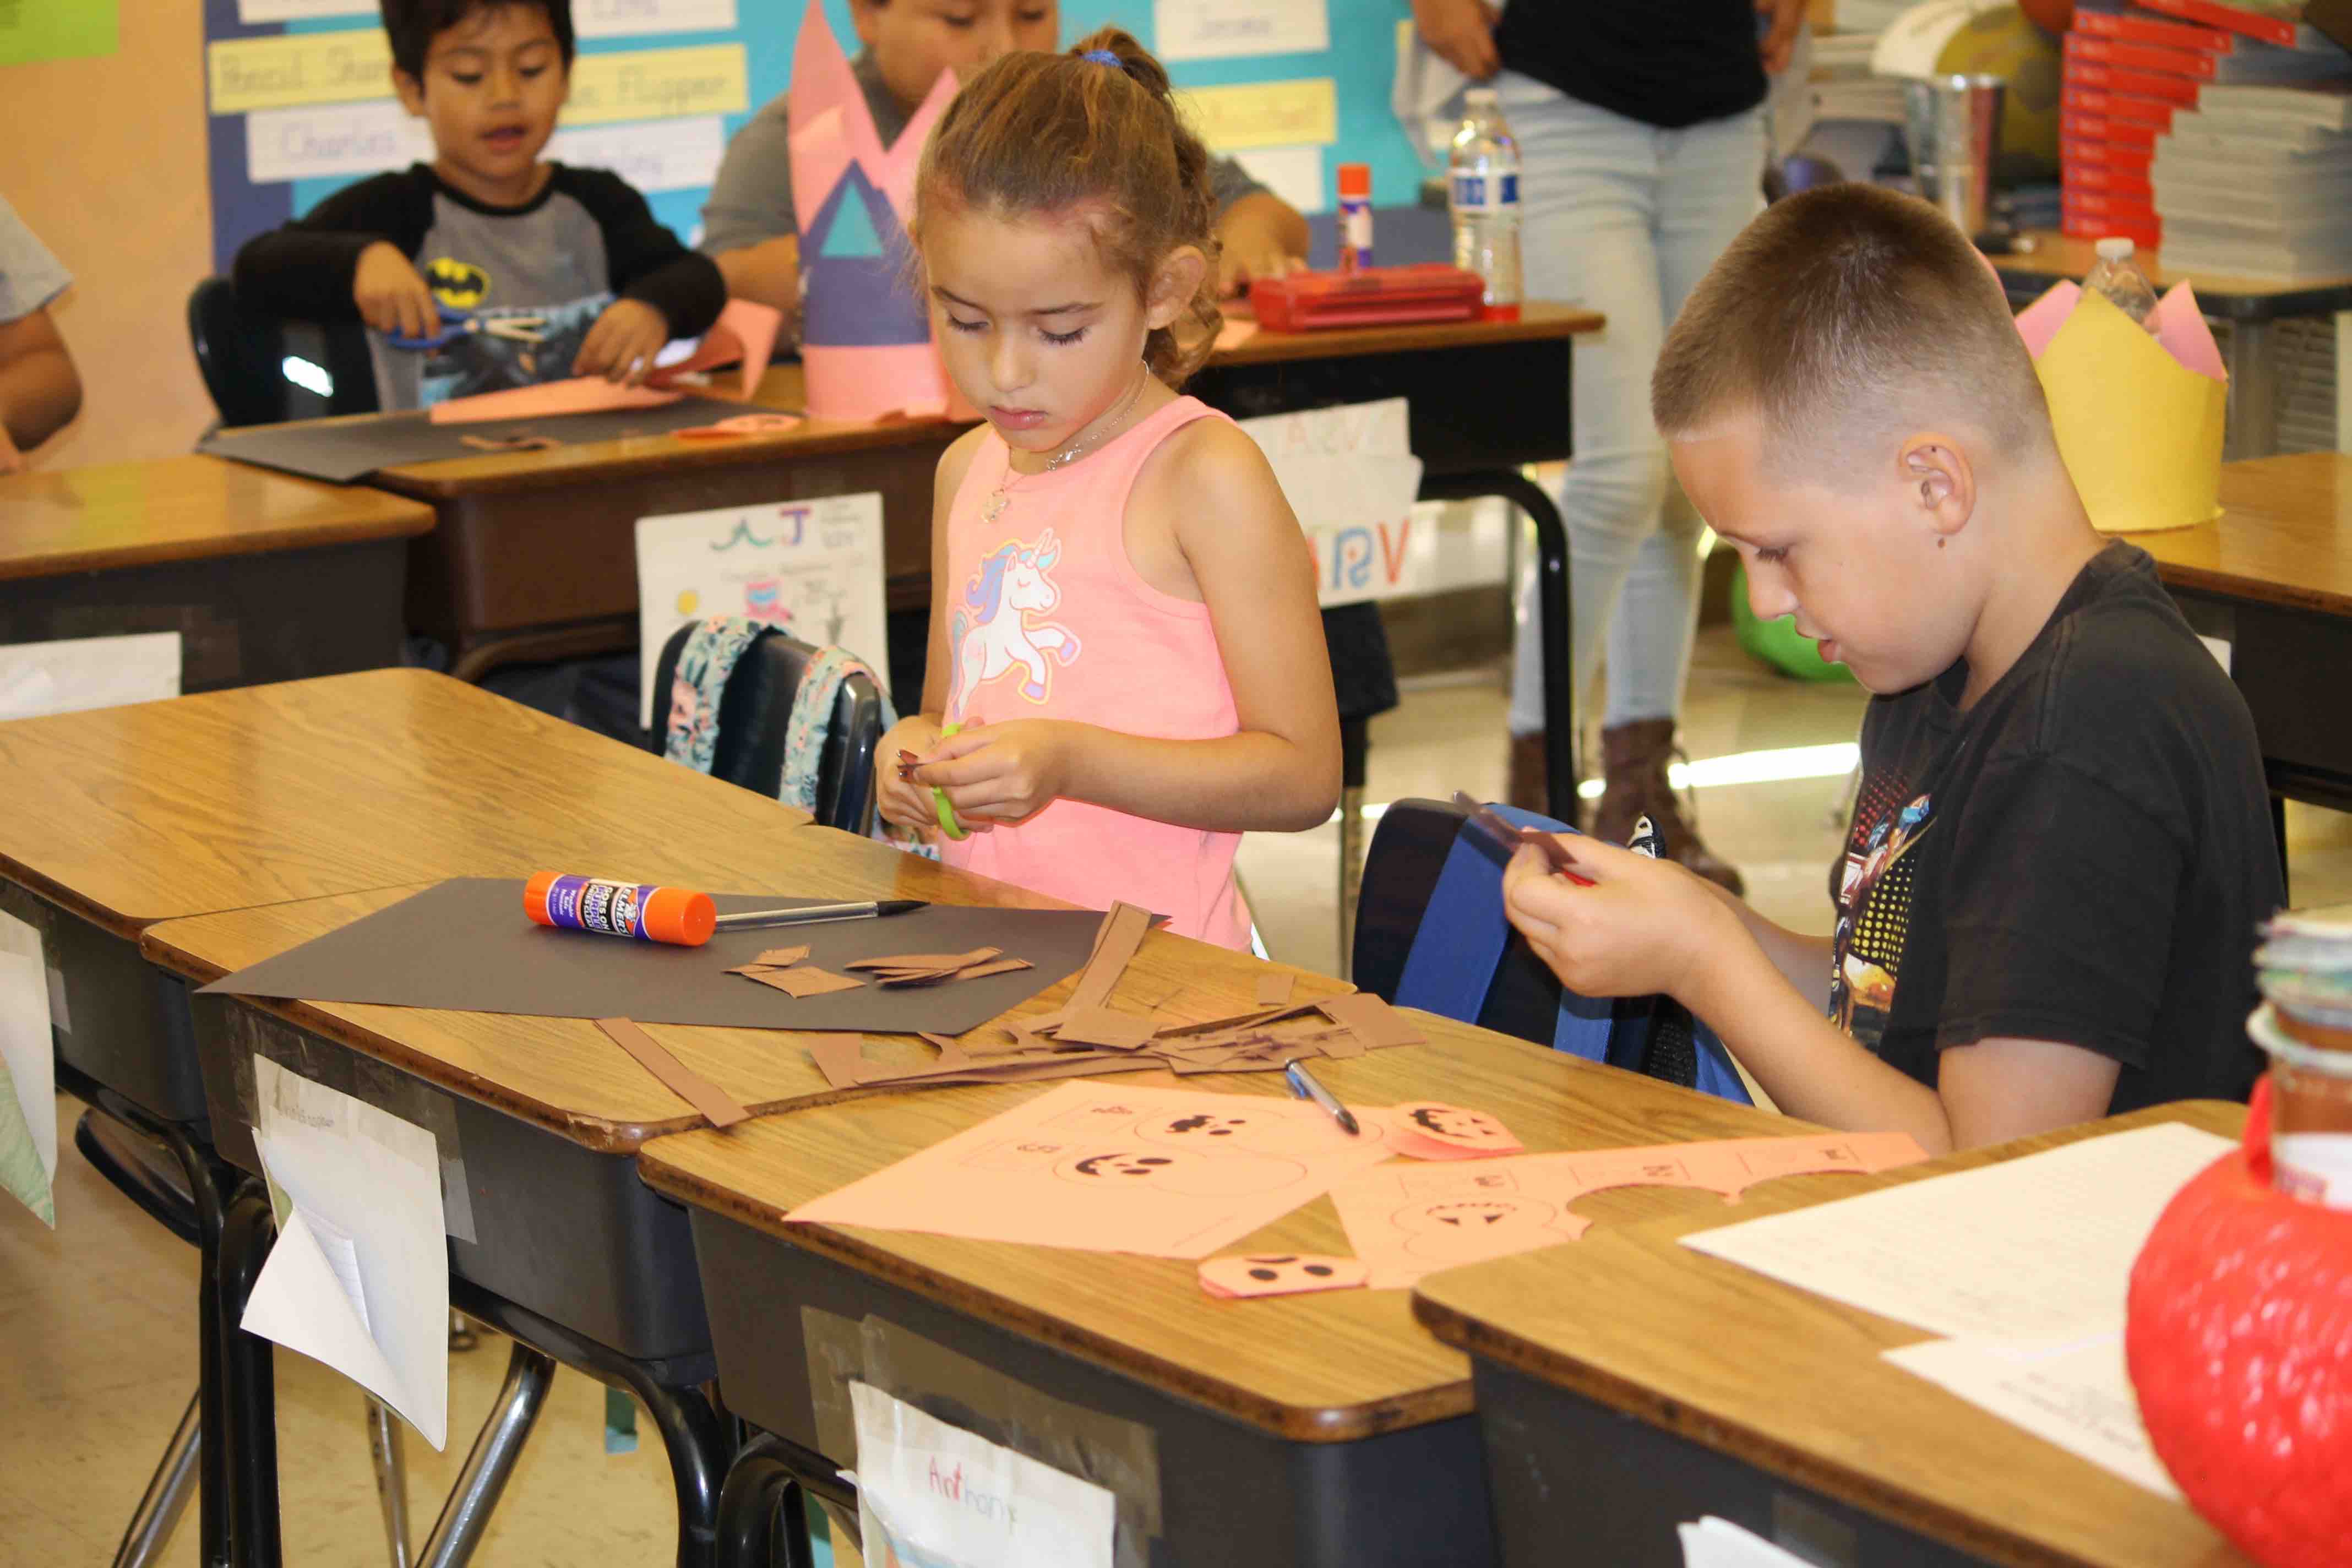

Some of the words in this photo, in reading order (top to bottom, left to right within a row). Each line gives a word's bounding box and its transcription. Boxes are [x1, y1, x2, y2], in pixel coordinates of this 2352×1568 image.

[591, 886, 607, 929] PURPLE
[599, 887, 613, 914] GOES
[600, 916, 610, 930] ON
[929, 1453, 1017, 1535] Anthony
